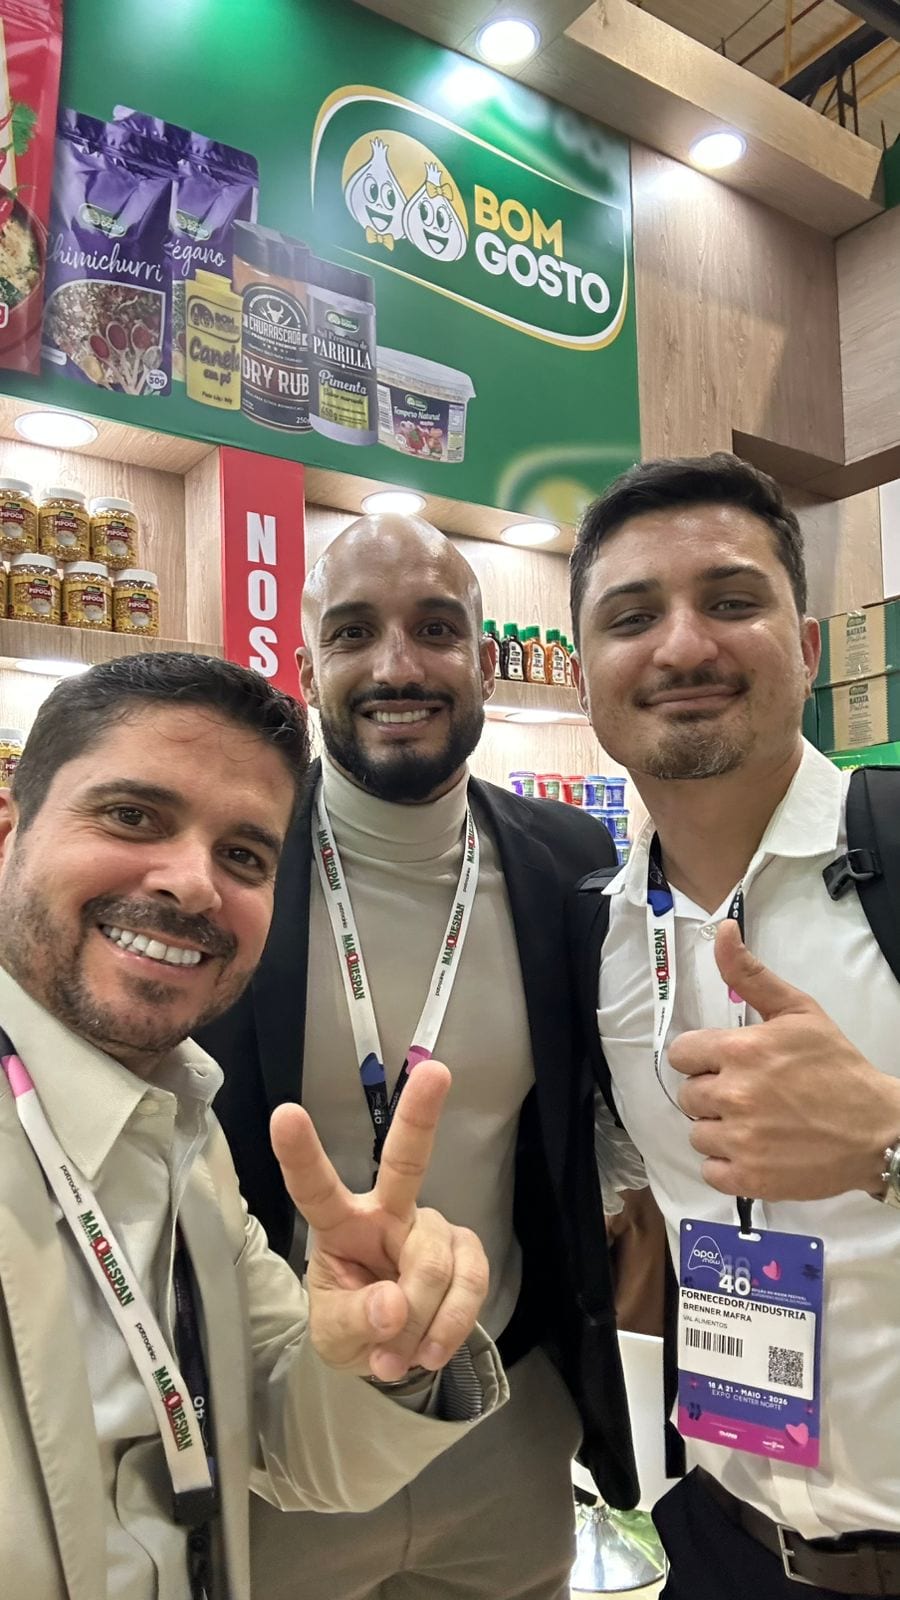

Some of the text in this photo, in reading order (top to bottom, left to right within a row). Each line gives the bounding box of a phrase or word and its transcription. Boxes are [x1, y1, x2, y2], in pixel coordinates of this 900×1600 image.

[474, 184, 564, 257] BOM
[47, 233, 163, 282] himichurri
[475, 231, 611, 314] GOSTO
[313, 335, 372, 370] PARRILLA
[149, 376, 165, 387] 30g
[242, 354, 309, 396] DRY RUB
[319, 369, 367, 394] Pimenta
[54, 519, 78, 529] PIPOCA
[106, 529, 129, 538] PIPOCA
[28, 587, 53, 596] PIPOCA
[81, 594, 105, 603] PIPOCA
[128, 601, 150, 609] PIPOCA
[846, 626, 867, 637] BATATA
[849, 695, 869, 705] BATATA
[655, 928, 670, 1001] MARQUESPAN
[80, 1209, 135, 1307] MARQUESPAN
[718, 1274, 751, 1296] 40
[681, 1289, 807, 1321] FORNECEDOR/INDUSTRIA
[683, 1302, 752, 1322] BRENNER MAFRA
[682, 1314, 728, 1329] VAL ALIMENTOS
[708, 1381, 716, 1389] 18
[725, 1385, 734, 1393] 21
[741, 1388, 761, 1399] MAIO
[769, 1394, 788, 1406] 2026
[711, 1388, 782, 1411] EXPO CENTER NORTE
[154, 1365, 193, 1451] MARQUESPAN
